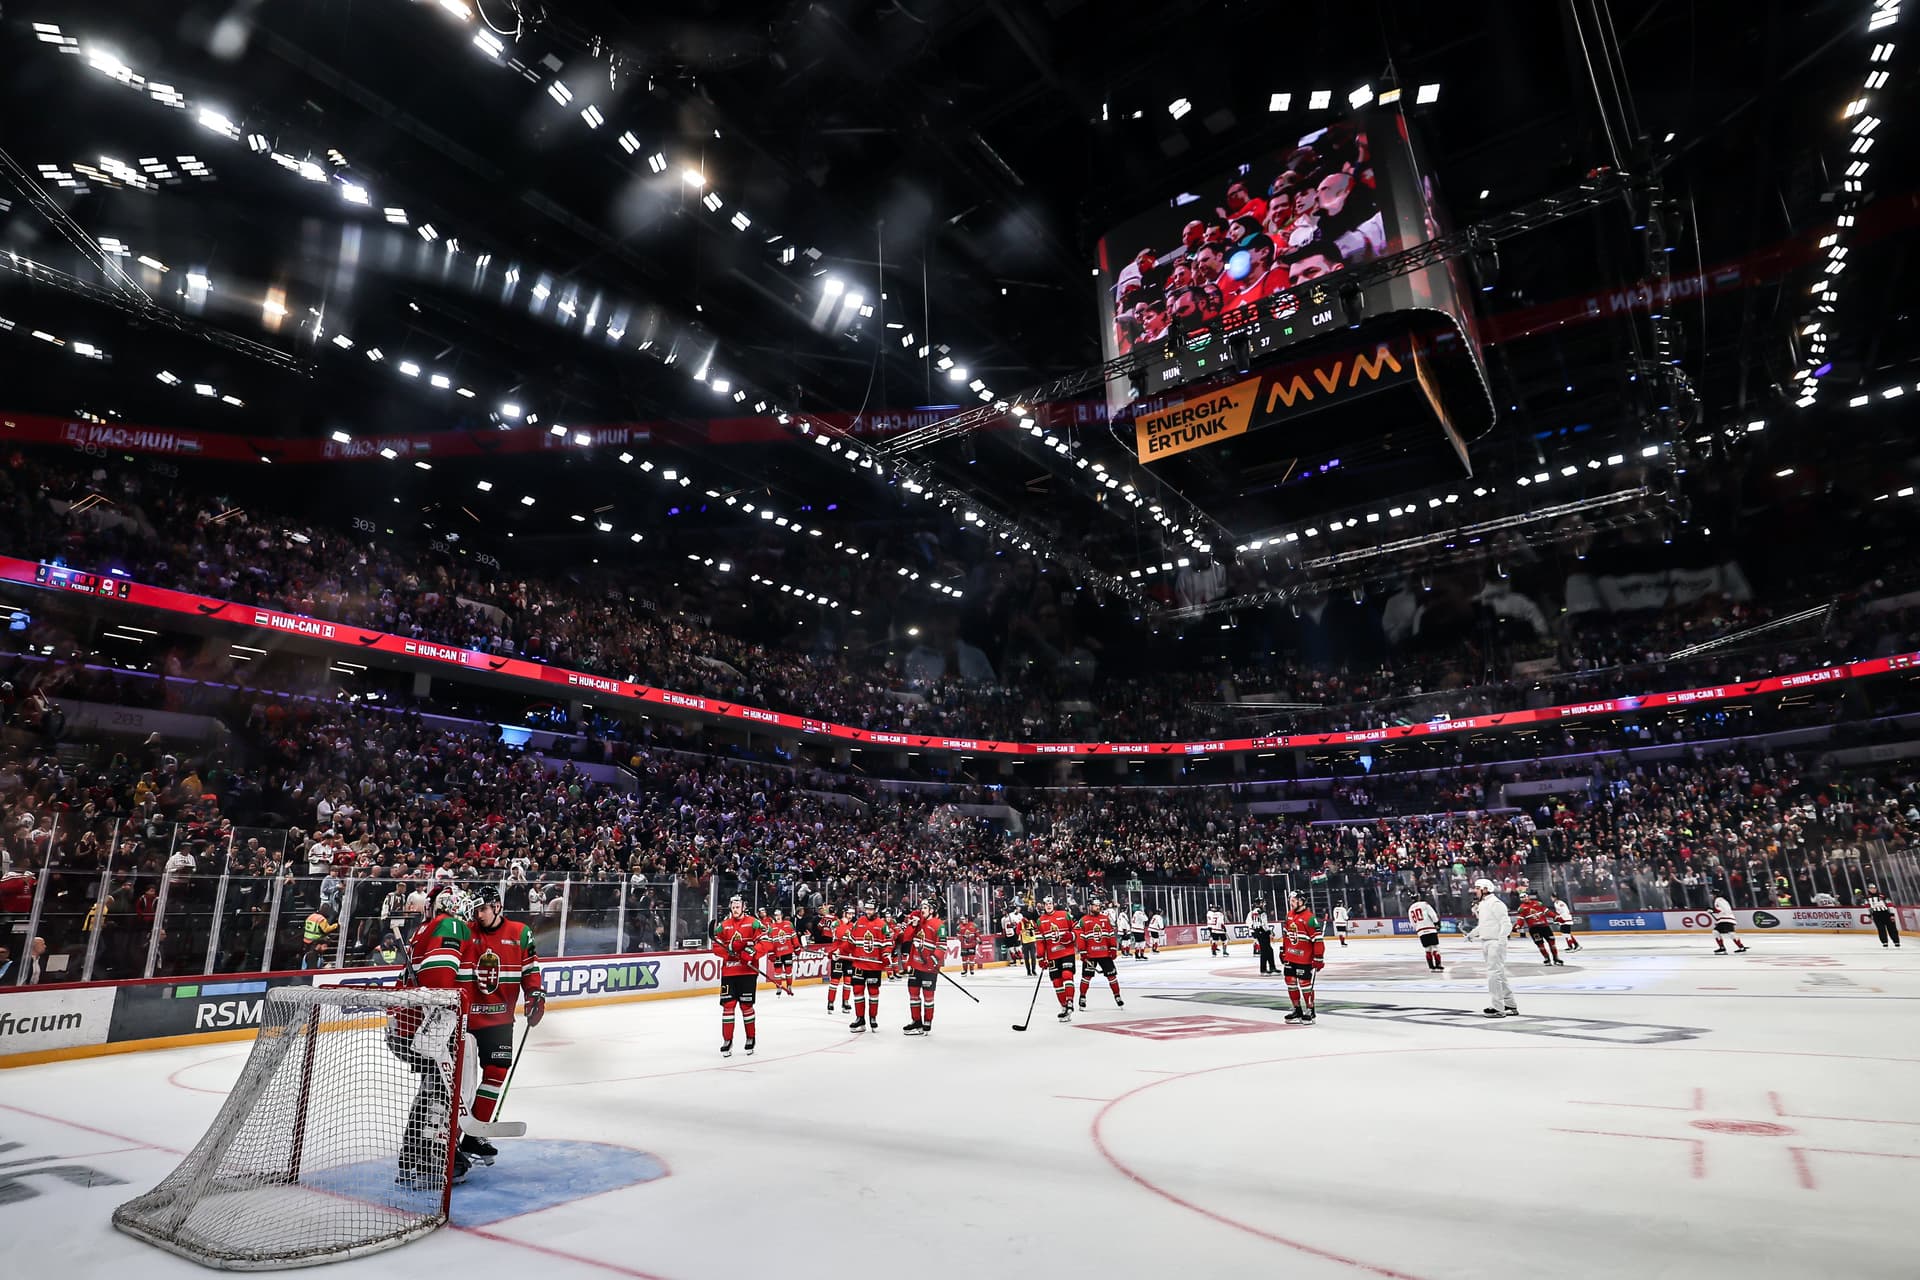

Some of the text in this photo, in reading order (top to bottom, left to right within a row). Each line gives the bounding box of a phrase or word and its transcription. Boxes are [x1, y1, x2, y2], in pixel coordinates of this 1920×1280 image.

[1312, 310, 1332, 326] CAN
[1259, 336, 1271, 347] 37
[1162, 366, 1181, 381] HUN
[1266, 346, 1403, 414] MVM
[1146, 394, 1239, 436] ENERGIA.
[1148, 415, 1228, 454] ÉRTÜNK
[352, 516, 376, 533] 303
[271, 615, 321, 634] HUN-CAN
[418, 644, 458, 661] HUN-CAN
[579, 675, 610, 690] HUN-CAN
[1791, 669, 1831, 685] HUN-CAN
[671, 694, 698, 708] HUN-CAN
[1677, 689, 1714, 702] HUN-CAN
[1571, 702, 1604, 715] HUN-CAN
[1609, 918, 1635, 927] ERSTE
[195, 999, 264, 1029] RSM
[0, 1012, 82, 1037] ficium
